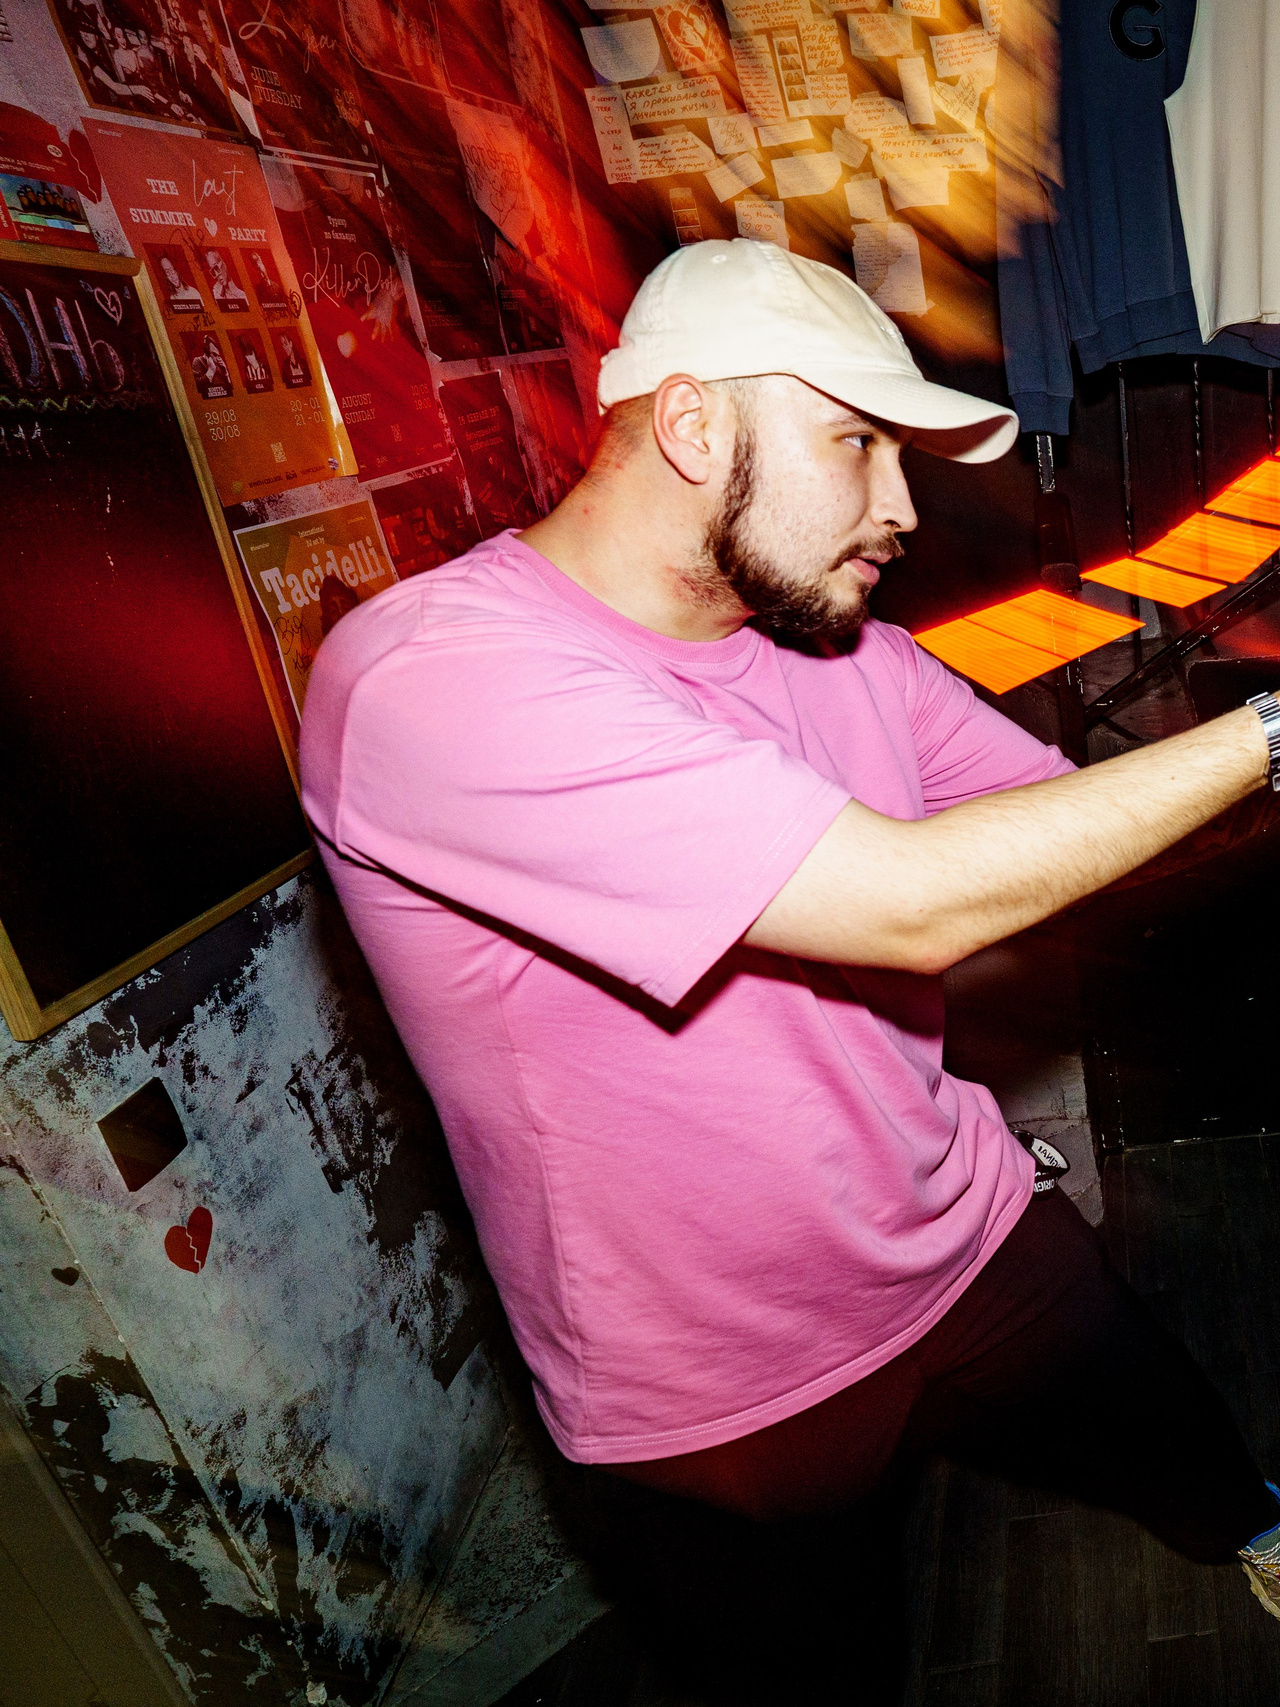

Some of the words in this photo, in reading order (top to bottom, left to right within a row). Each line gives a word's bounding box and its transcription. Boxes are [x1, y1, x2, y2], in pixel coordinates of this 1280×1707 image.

[251, 65, 281, 87] JUNE
[625, 86, 672, 100] КАЖЕТСЯ
[677, 77, 715, 91] СЕЙЧАС
[254, 86, 303, 110] TUESDAY
[630, 102, 637, 111] Я
[146, 178, 179, 196] THE
[192, 159, 244, 216] Last
[129, 208, 196, 227] SUMMER
[228, 227, 267, 242] PARTY
[327, 215, 347, 228] Турнир
[290, 400, 302, 413] 20
[310, 397, 321, 410] 01
[341, 393, 373, 409] AUGUST
[205, 408, 237, 426] 29/08
[295, 414, 306, 427] 21
[314, 411, 325, 423] 01
[344, 408, 376, 425] SUNDAY
[209, 424, 241, 443] 30/08
[298, 524, 325, 538] International
[260, 536, 385, 614] Tacidelli
